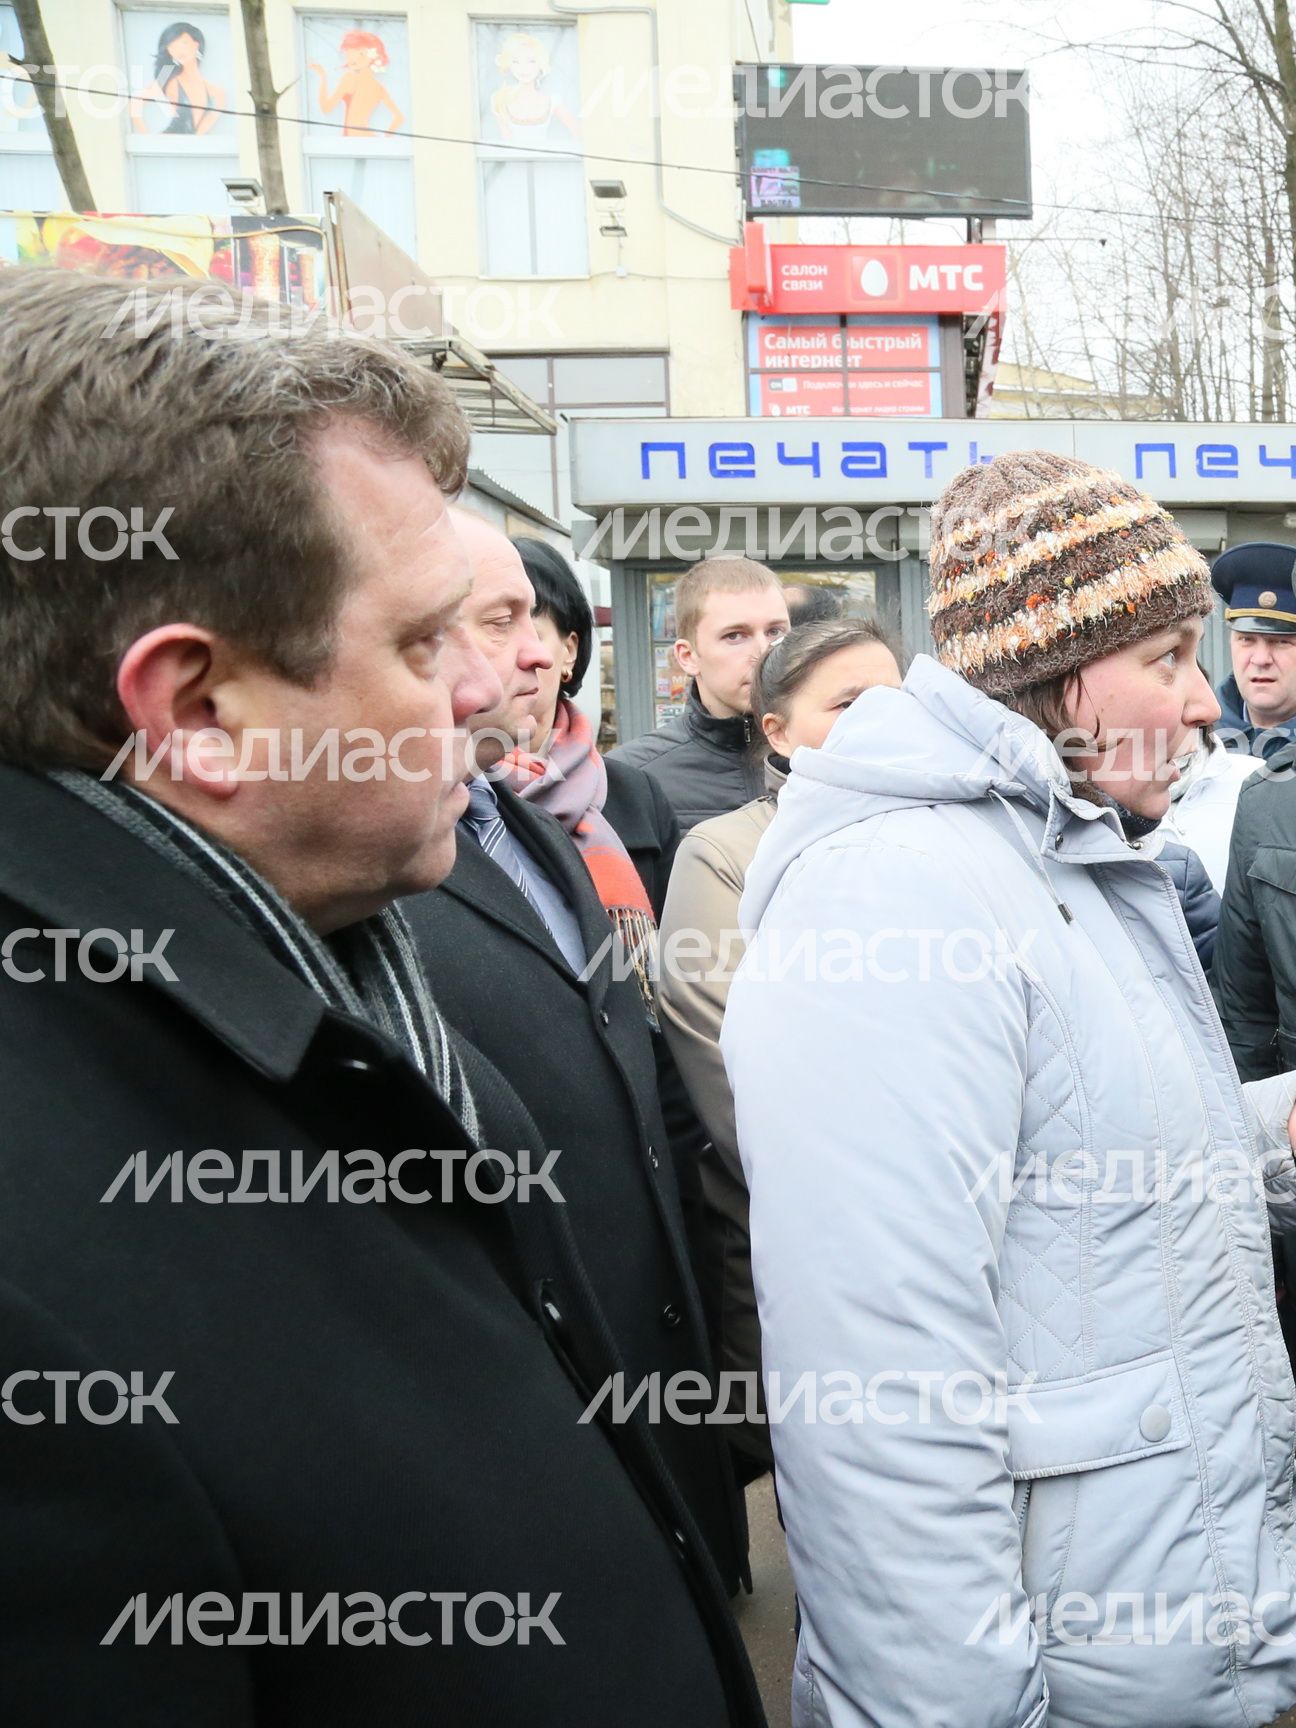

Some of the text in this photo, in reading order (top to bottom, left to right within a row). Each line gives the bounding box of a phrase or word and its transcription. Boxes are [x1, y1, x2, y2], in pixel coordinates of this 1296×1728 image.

[781, 264, 828, 276] салон
[908, 264, 984, 291] МТС
[781, 279, 823, 291] связи
[764, 333, 922, 351] Самый быстрый
[764, 354, 863, 367] интернет
